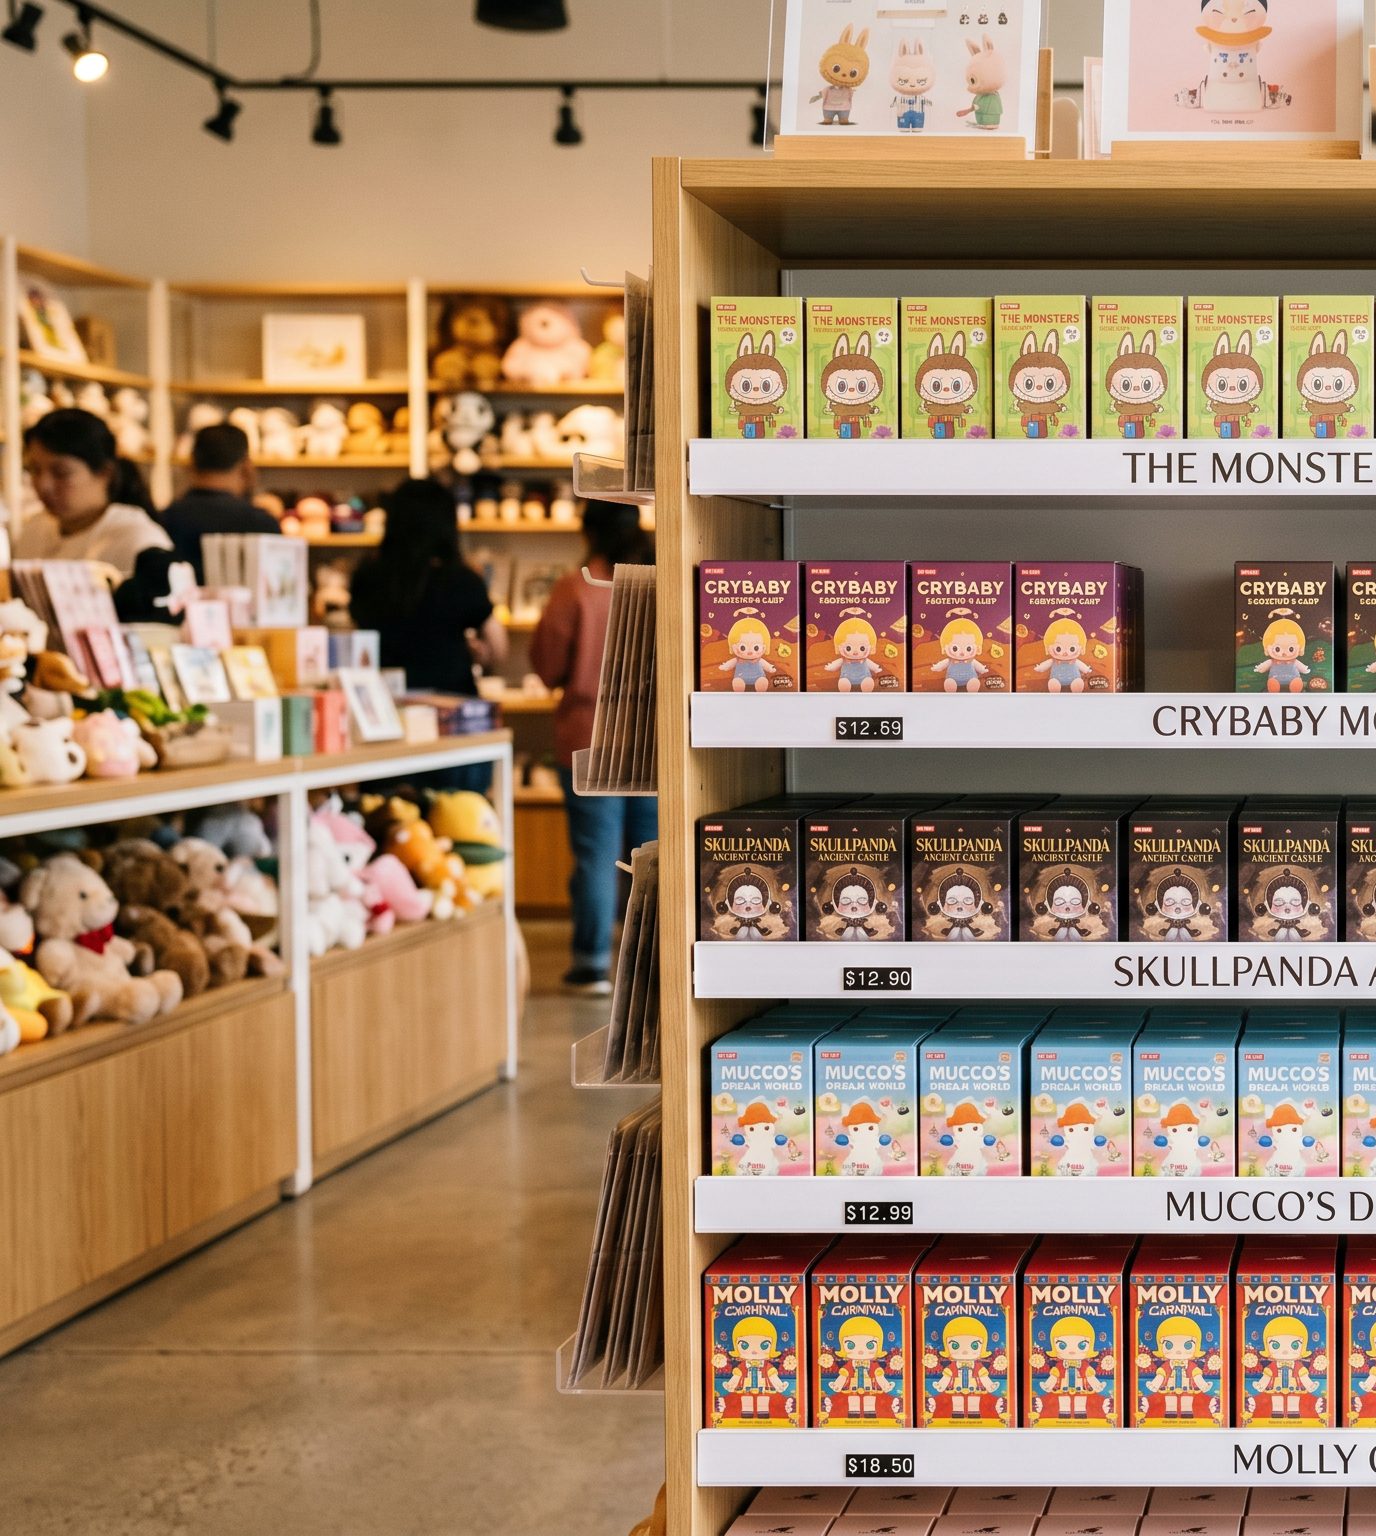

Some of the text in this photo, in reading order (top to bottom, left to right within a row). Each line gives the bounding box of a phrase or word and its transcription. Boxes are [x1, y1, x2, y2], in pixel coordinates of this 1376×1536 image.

[740, 316, 796, 325] MONSTERS
[813, 316, 892, 325] THE MONSTERS
[908, 316, 986, 325] THE MONSTERS
[1024, 314, 1079, 323] MONSTERS
[1099, 315, 1177, 324] THE MONSTERS
[1195, 315, 1272, 324] THE MONSTERS
[1313, 315, 1368, 324] MONSTERS
[1123, 452, 1197, 483] THE
[704, 581, 791, 594] CRYBABY
[811, 581, 898, 594] CRYBABY
[917, 581, 1004, 595] CRYBABY
[1021, 582, 1108, 595] CRYBABY
[1240, 581, 1326, 595] CRYBABY
[1153, 706, 1327, 736] CRYBABY
[704, 838, 790, 851] SKULLPANDA
[810, 838, 897, 852] SKULLPANDA
[916, 838, 1003, 852] SKULLPANDA
[1023, 838, 1110, 852] SKULLPANDA
[1133, 839, 1221, 853] SKULLPANDA
[1243, 839, 1330, 853] SKULLPANDA
[818, 853, 889, 861] ANCIENT CASTLE
[1141, 854, 1179, 862] ANCIENT
[1115, 956, 1358, 986] SKULLPANDA
[845, 970, 911, 987] $12.90
[721, 1065, 802, 1080] MUCCO'S
[825, 1065, 905, 1080] MUCCO'S
[929, 1065, 1010, 1081] MUCCO'S
[1040, 1066, 1121, 1081] MUCCO'S
[1143, 1066, 1225, 1082] MUCCO'S
[1248, 1066, 1330, 1082] MUCCO'S
[847, 1204, 911, 1221] $12.99
[1167, 1191, 1335, 1221] MUCCO'S
[713, 1286, 797, 1304] MOLLY
[820, 1285, 904, 1304] MOLLY
[923, 1286, 1008, 1304] MOLLY
[1031, 1286, 1117, 1304] MOLLY
[1137, 1285, 1221, 1305] MOLLY
[1244, 1285, 1328, 1304] MOLLY
[849, 1457, 913, 1474] $18.50
[1235, 1445, 1357, 1475] MOLLY
